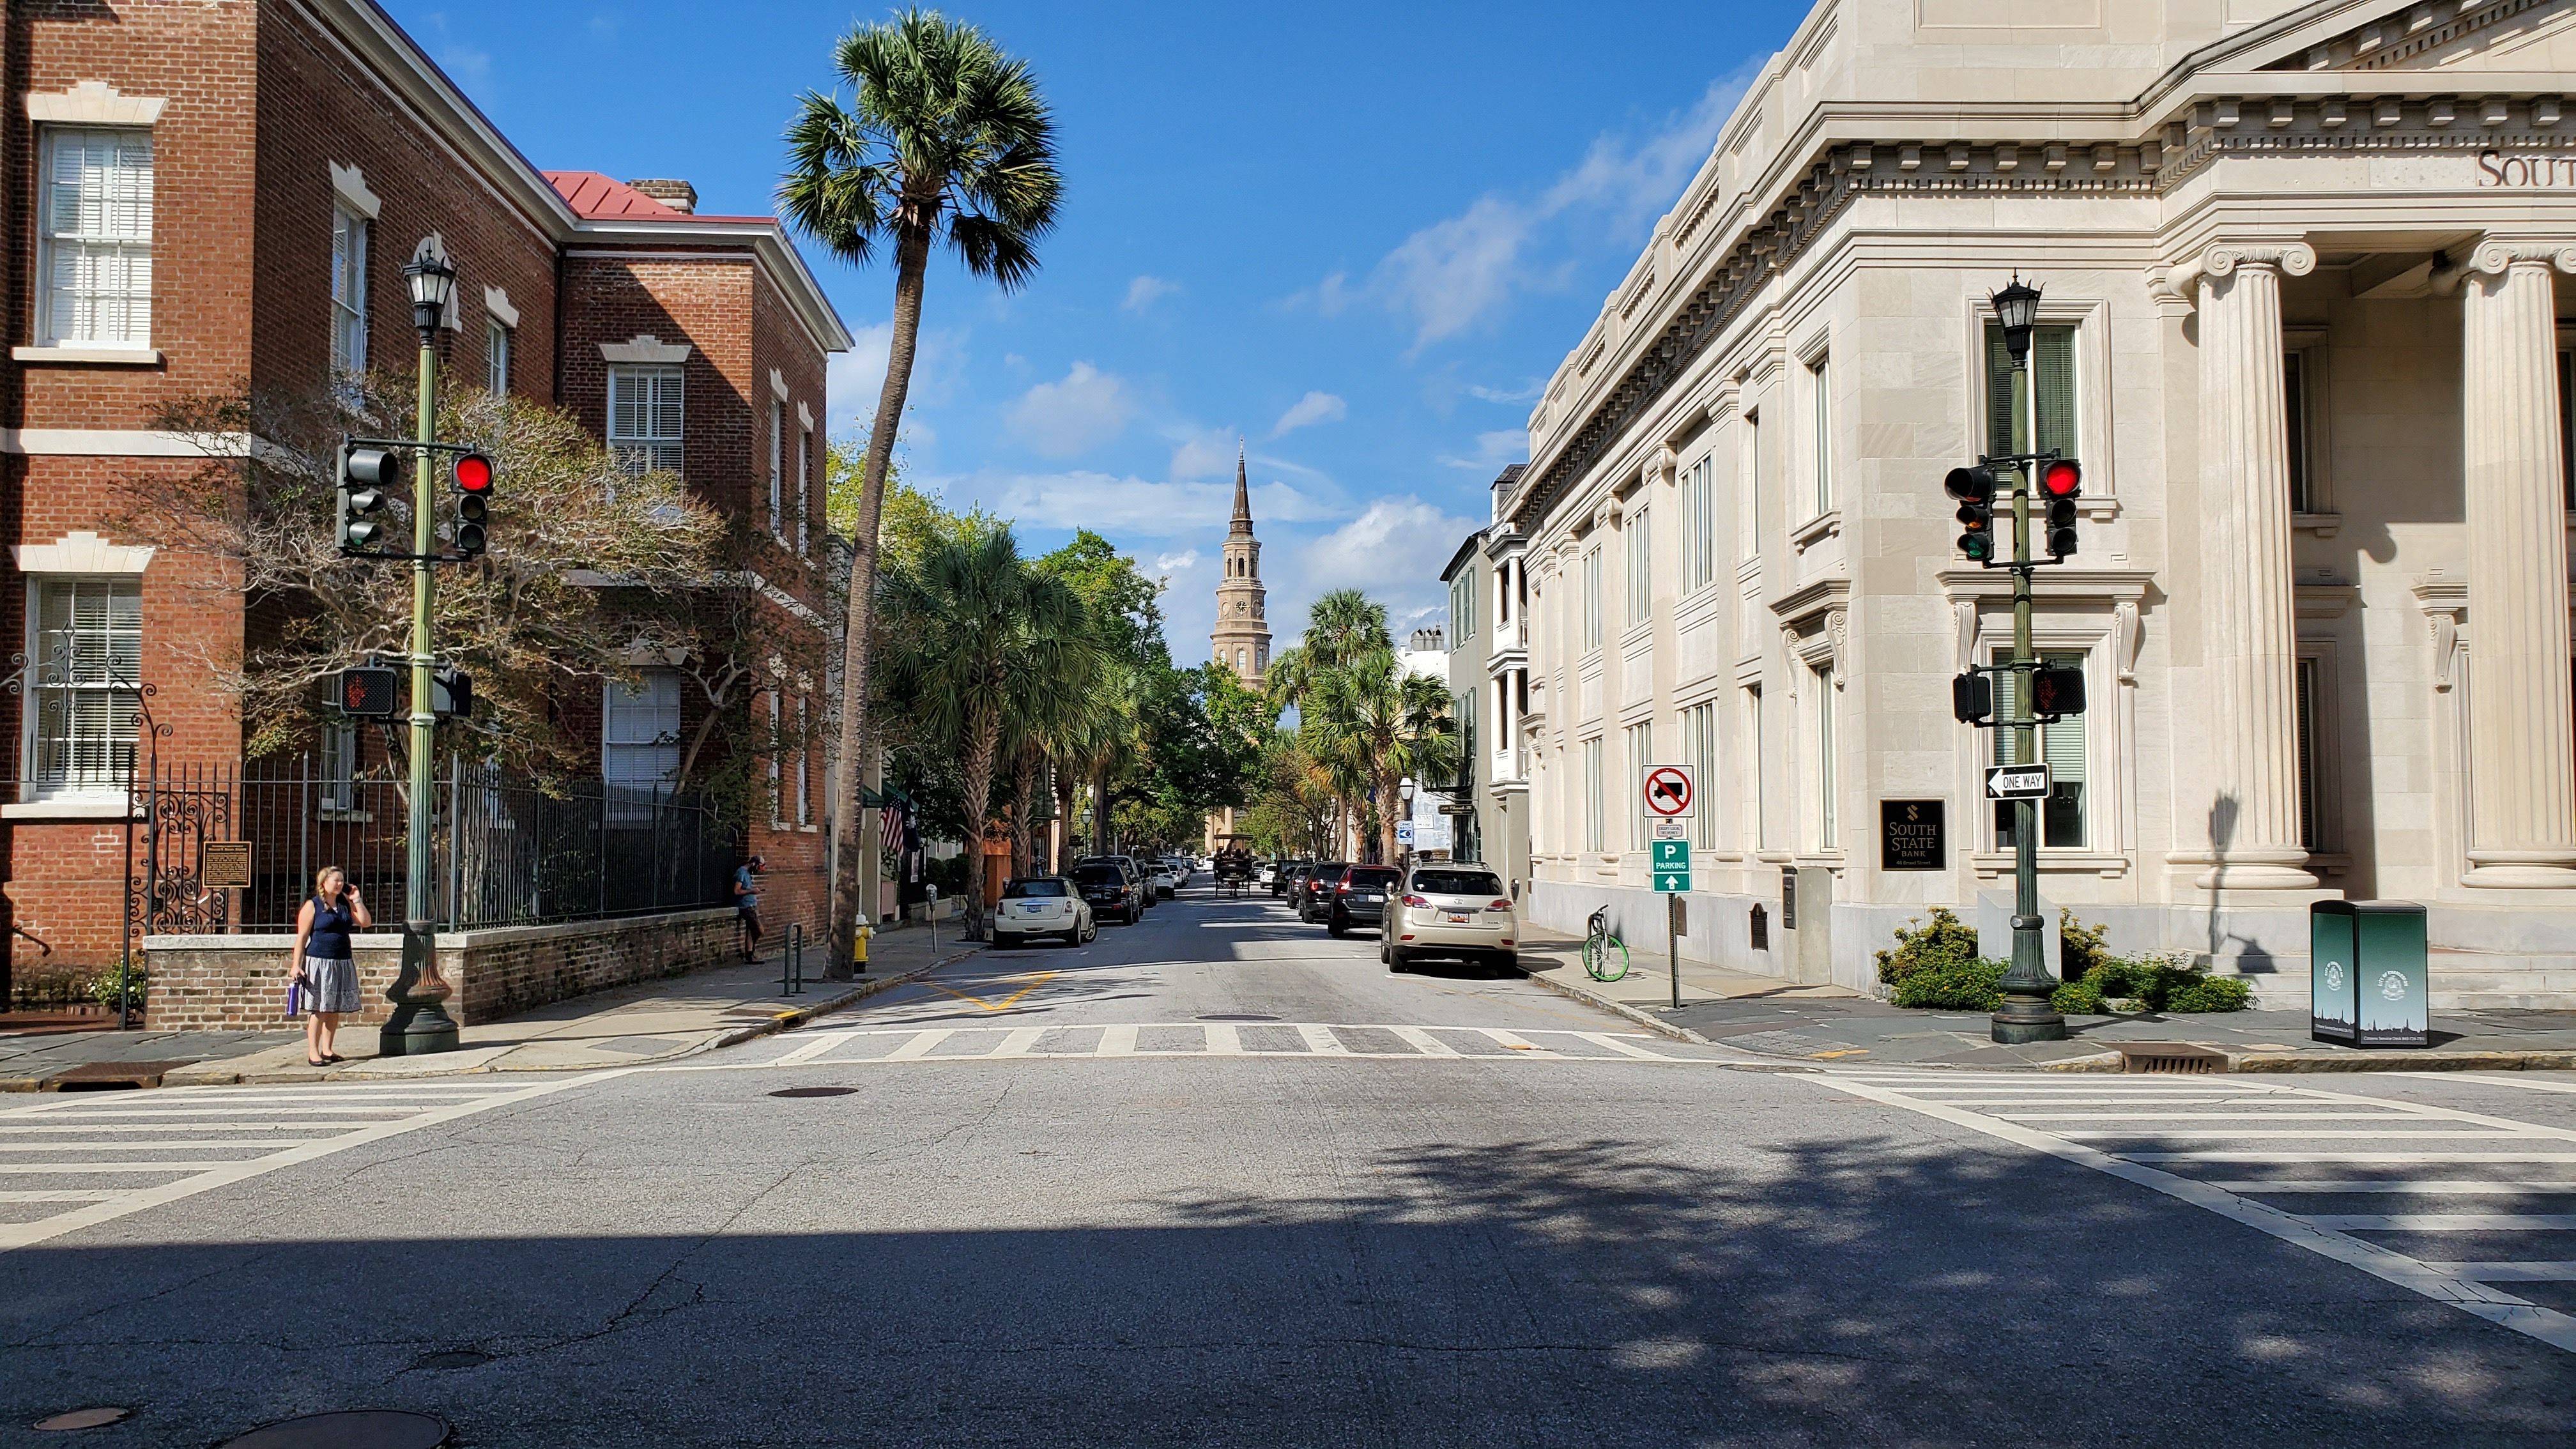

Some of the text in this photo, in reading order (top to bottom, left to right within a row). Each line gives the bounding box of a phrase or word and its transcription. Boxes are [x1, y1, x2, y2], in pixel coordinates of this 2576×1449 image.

[2004, 774, 2041, 788] ONE WAY
[1889, 822, 1937, 836] SOUTH
[1892, 838, 1935, 851] STATE
[1664, 845, 1676, 859] P
